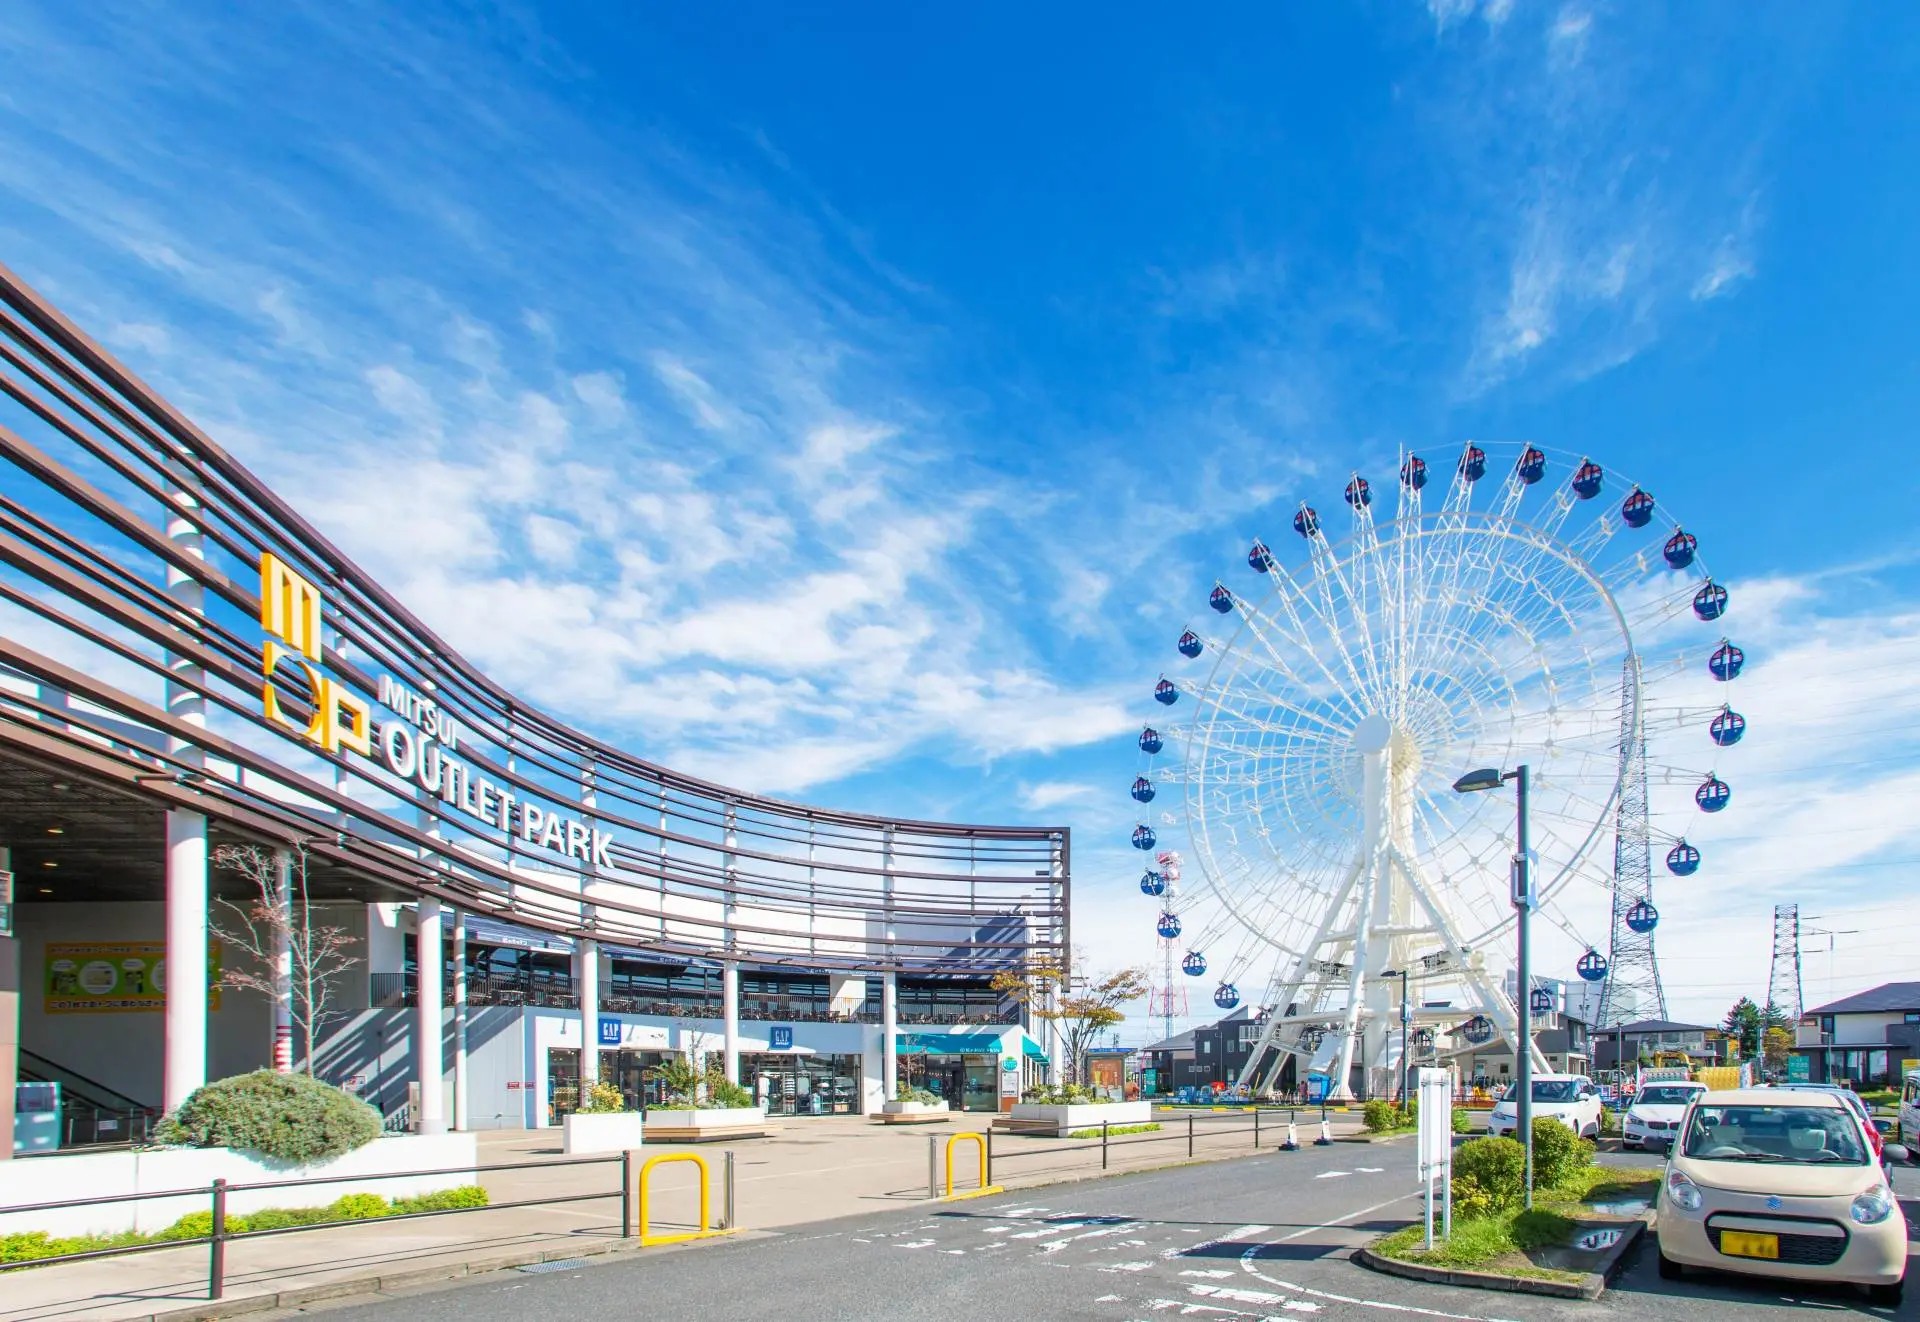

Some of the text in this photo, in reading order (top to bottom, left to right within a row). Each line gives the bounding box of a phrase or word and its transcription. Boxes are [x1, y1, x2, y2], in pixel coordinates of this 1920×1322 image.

[380, 675, 458, 750] MITSUI
[380, 722, 614, 868] OUTLET PARK
[603, 1023, 619, 1037] GAP
[775, 1030, 790, 1042] GAP
